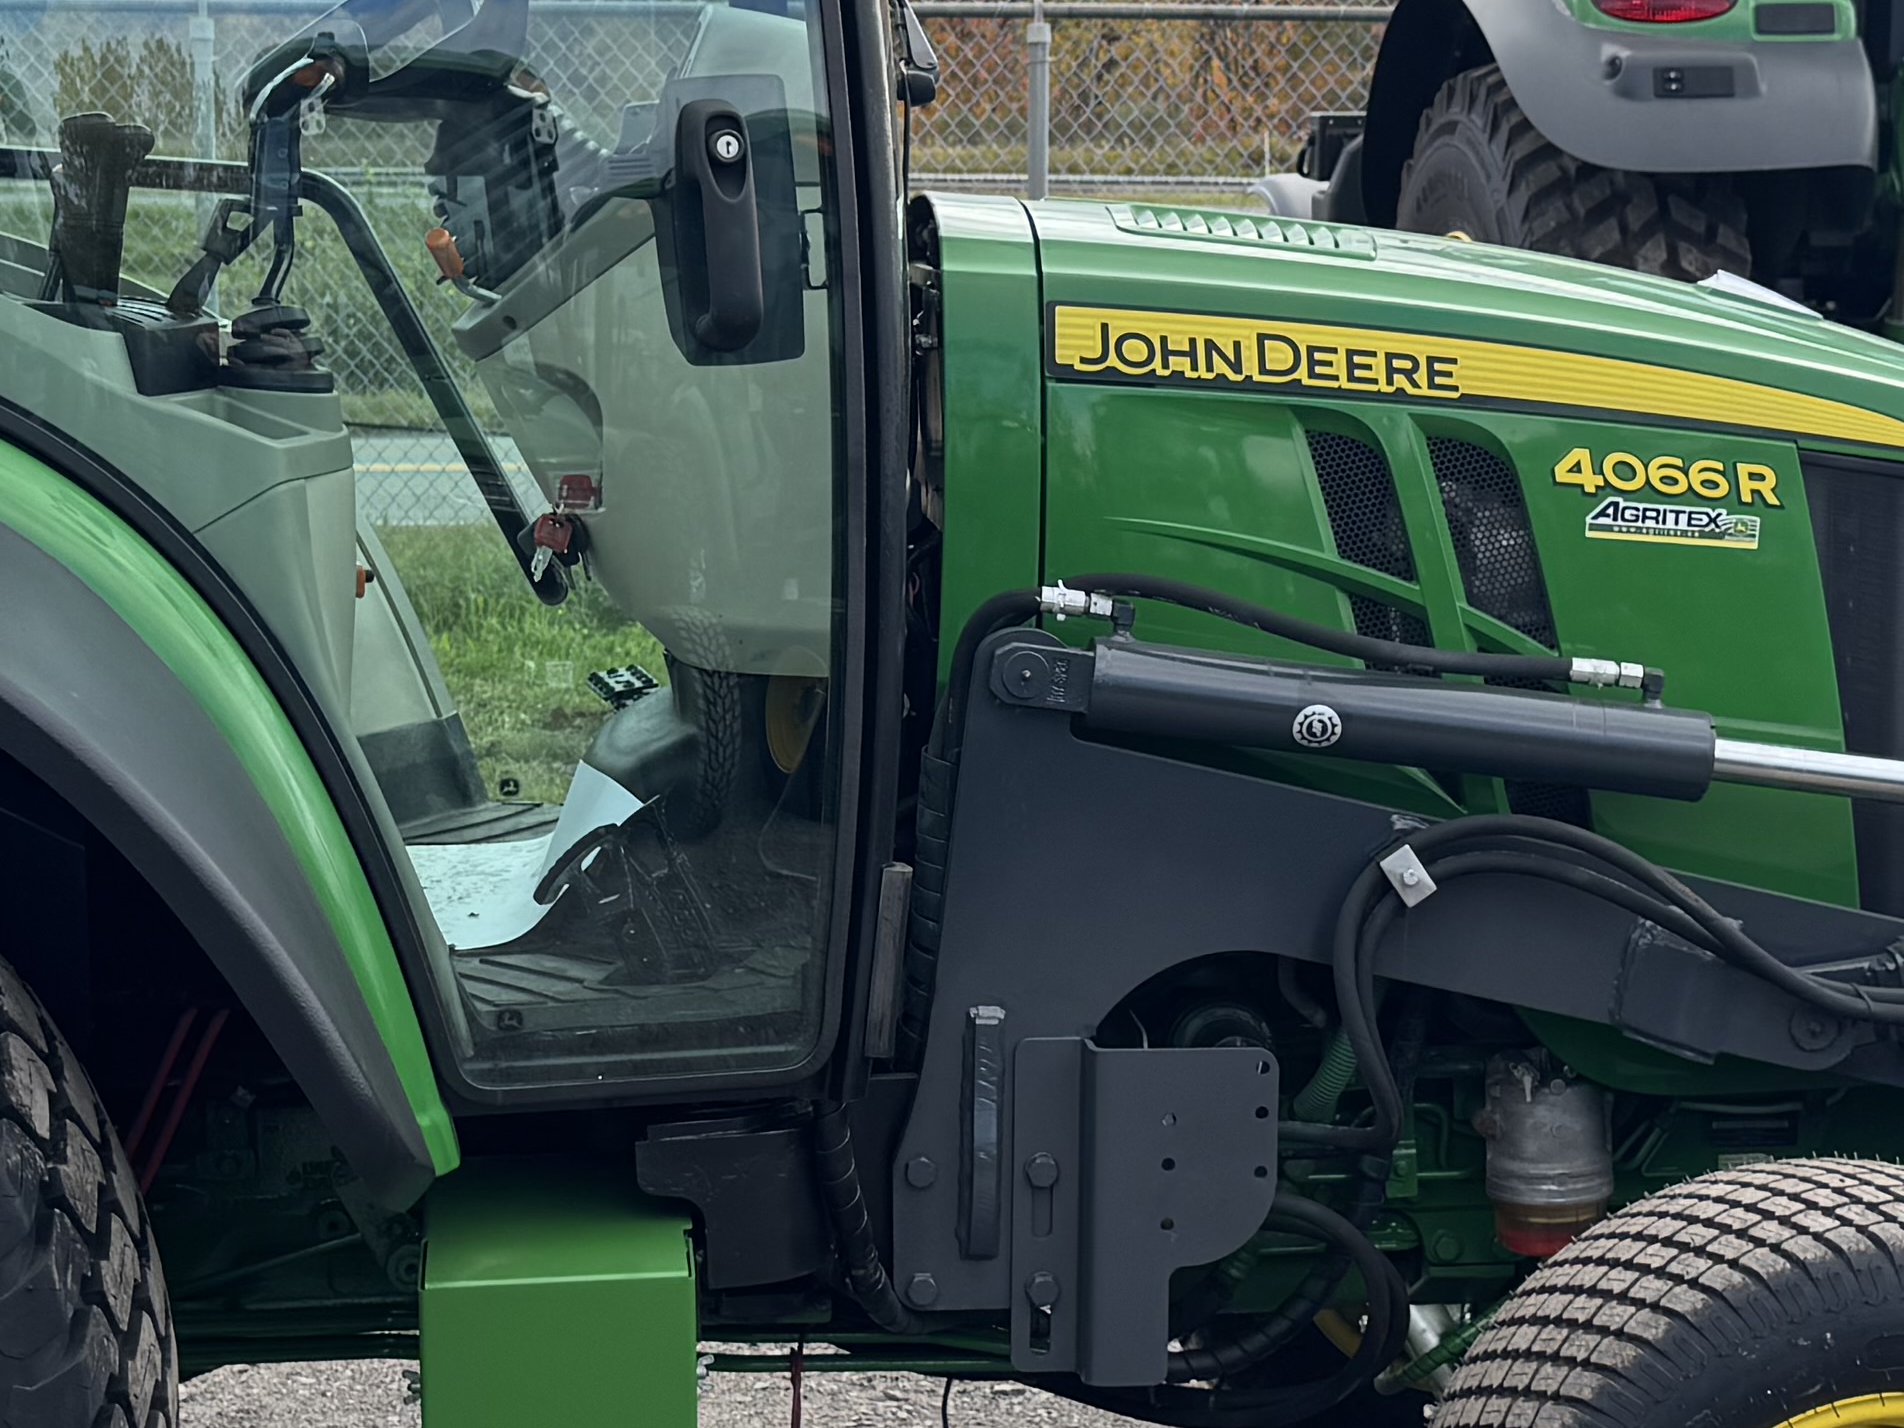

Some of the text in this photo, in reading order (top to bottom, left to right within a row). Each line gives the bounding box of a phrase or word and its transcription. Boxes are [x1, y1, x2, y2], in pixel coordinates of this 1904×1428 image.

[1079, 322, 1460, 393] JOHN DEERE
[1590, 500, 1724, 530] AGRITEX
